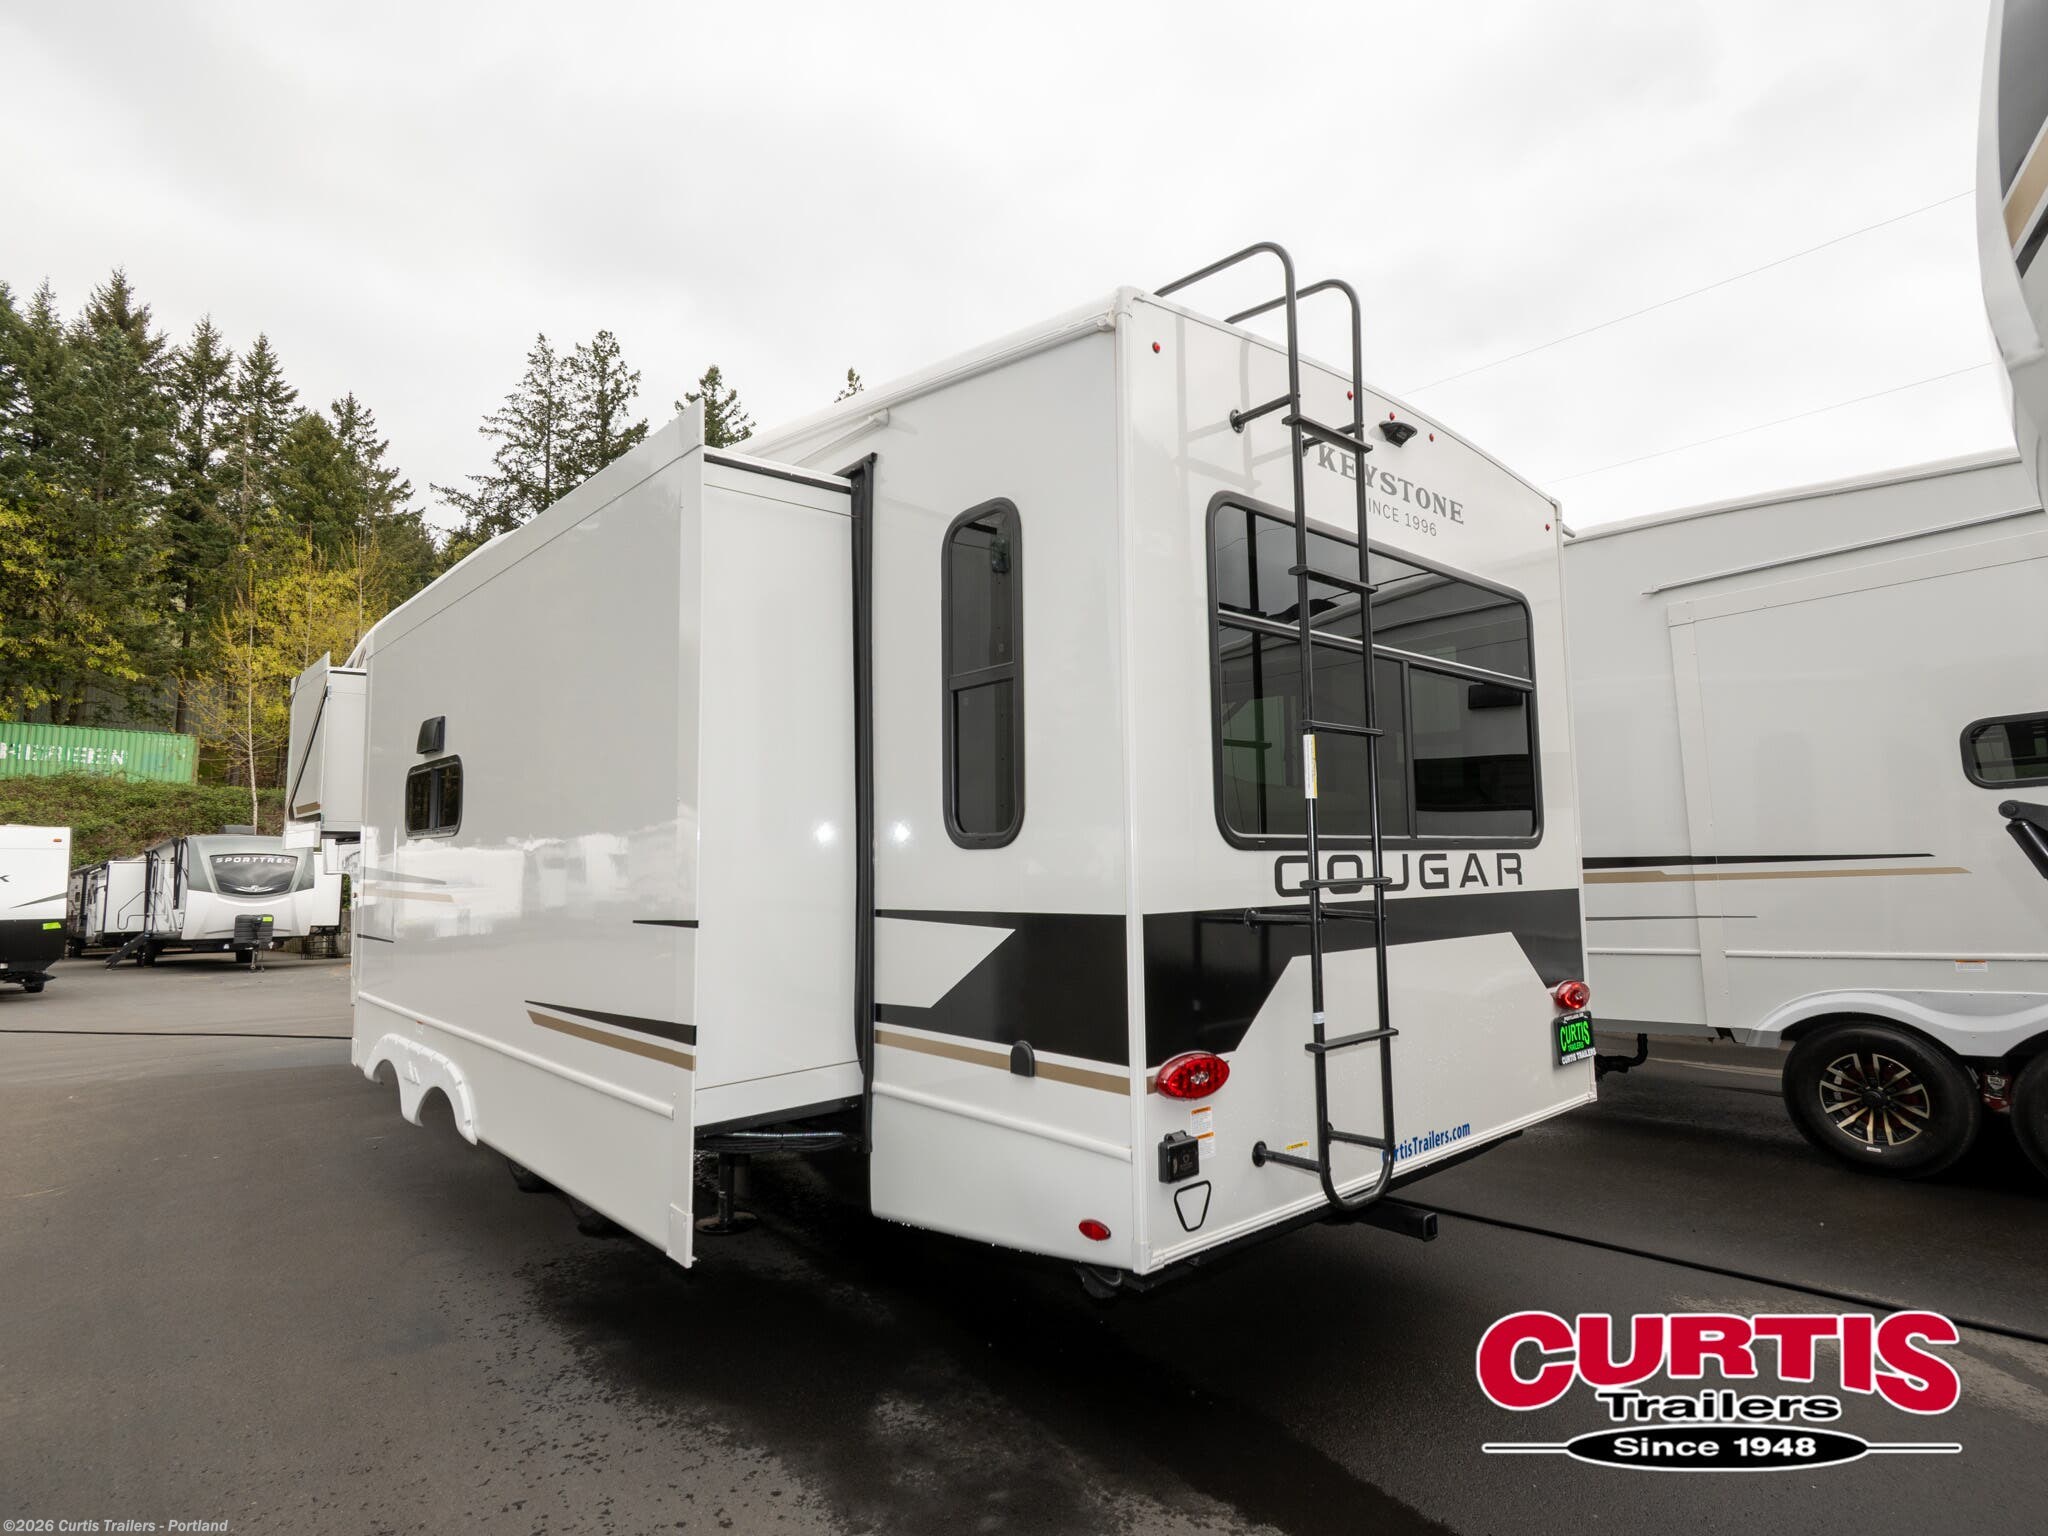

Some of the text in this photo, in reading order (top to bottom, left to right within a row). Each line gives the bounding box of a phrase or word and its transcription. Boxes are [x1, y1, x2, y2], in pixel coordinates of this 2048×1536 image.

[1317, 444, 1465, 525] KEYSTONE
[1368, 497, 1437, 537] INCE 1996
[215, 856, 292, 864] SPORTTREK
[1560, 1020, 1590, 1052] CURTIS
